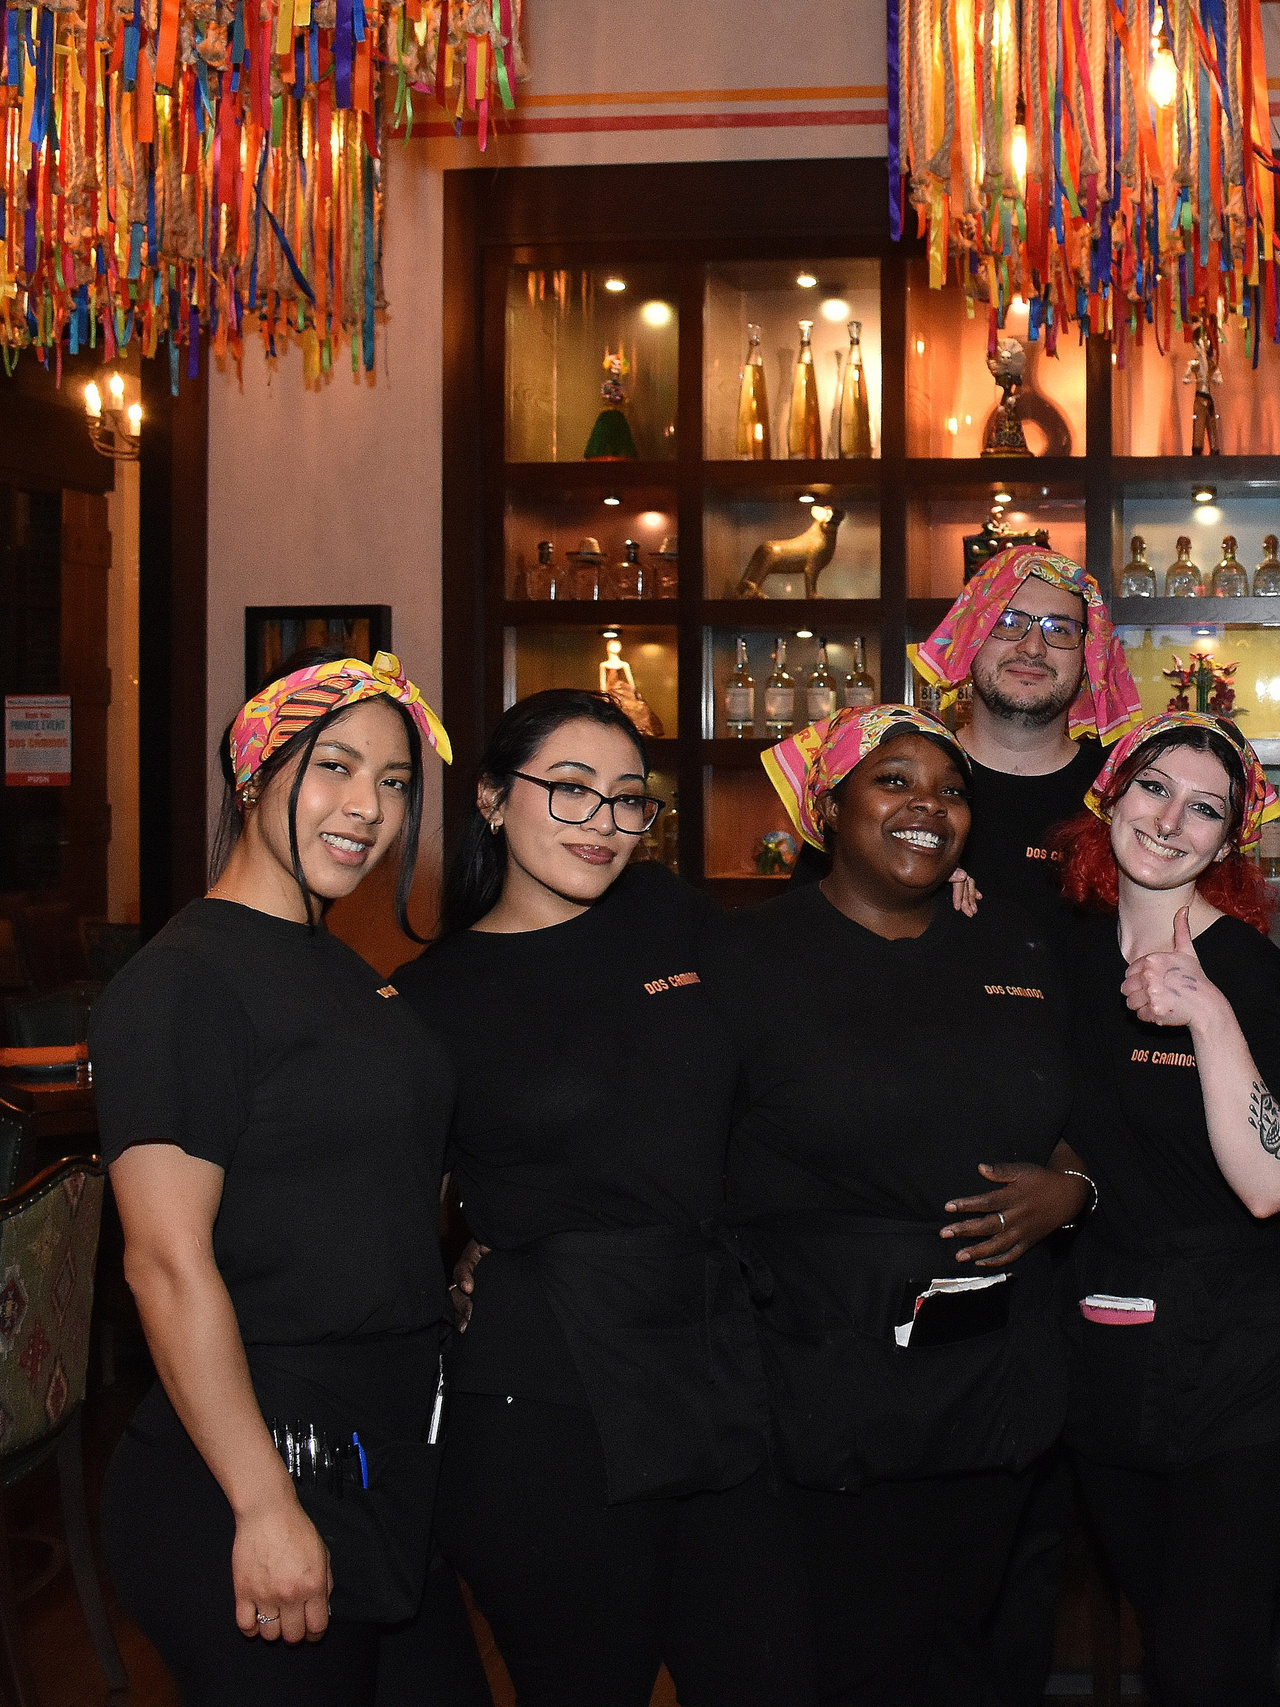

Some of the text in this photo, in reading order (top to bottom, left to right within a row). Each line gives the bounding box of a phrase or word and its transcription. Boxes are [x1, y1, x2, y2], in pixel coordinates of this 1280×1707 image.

[1026, 846, 1047, 860] DOS
[644, 978, 669, 995] DOS
[984, 985, 1005, 995] DOS
[1130, 1049, 1149, 1062] DOS
